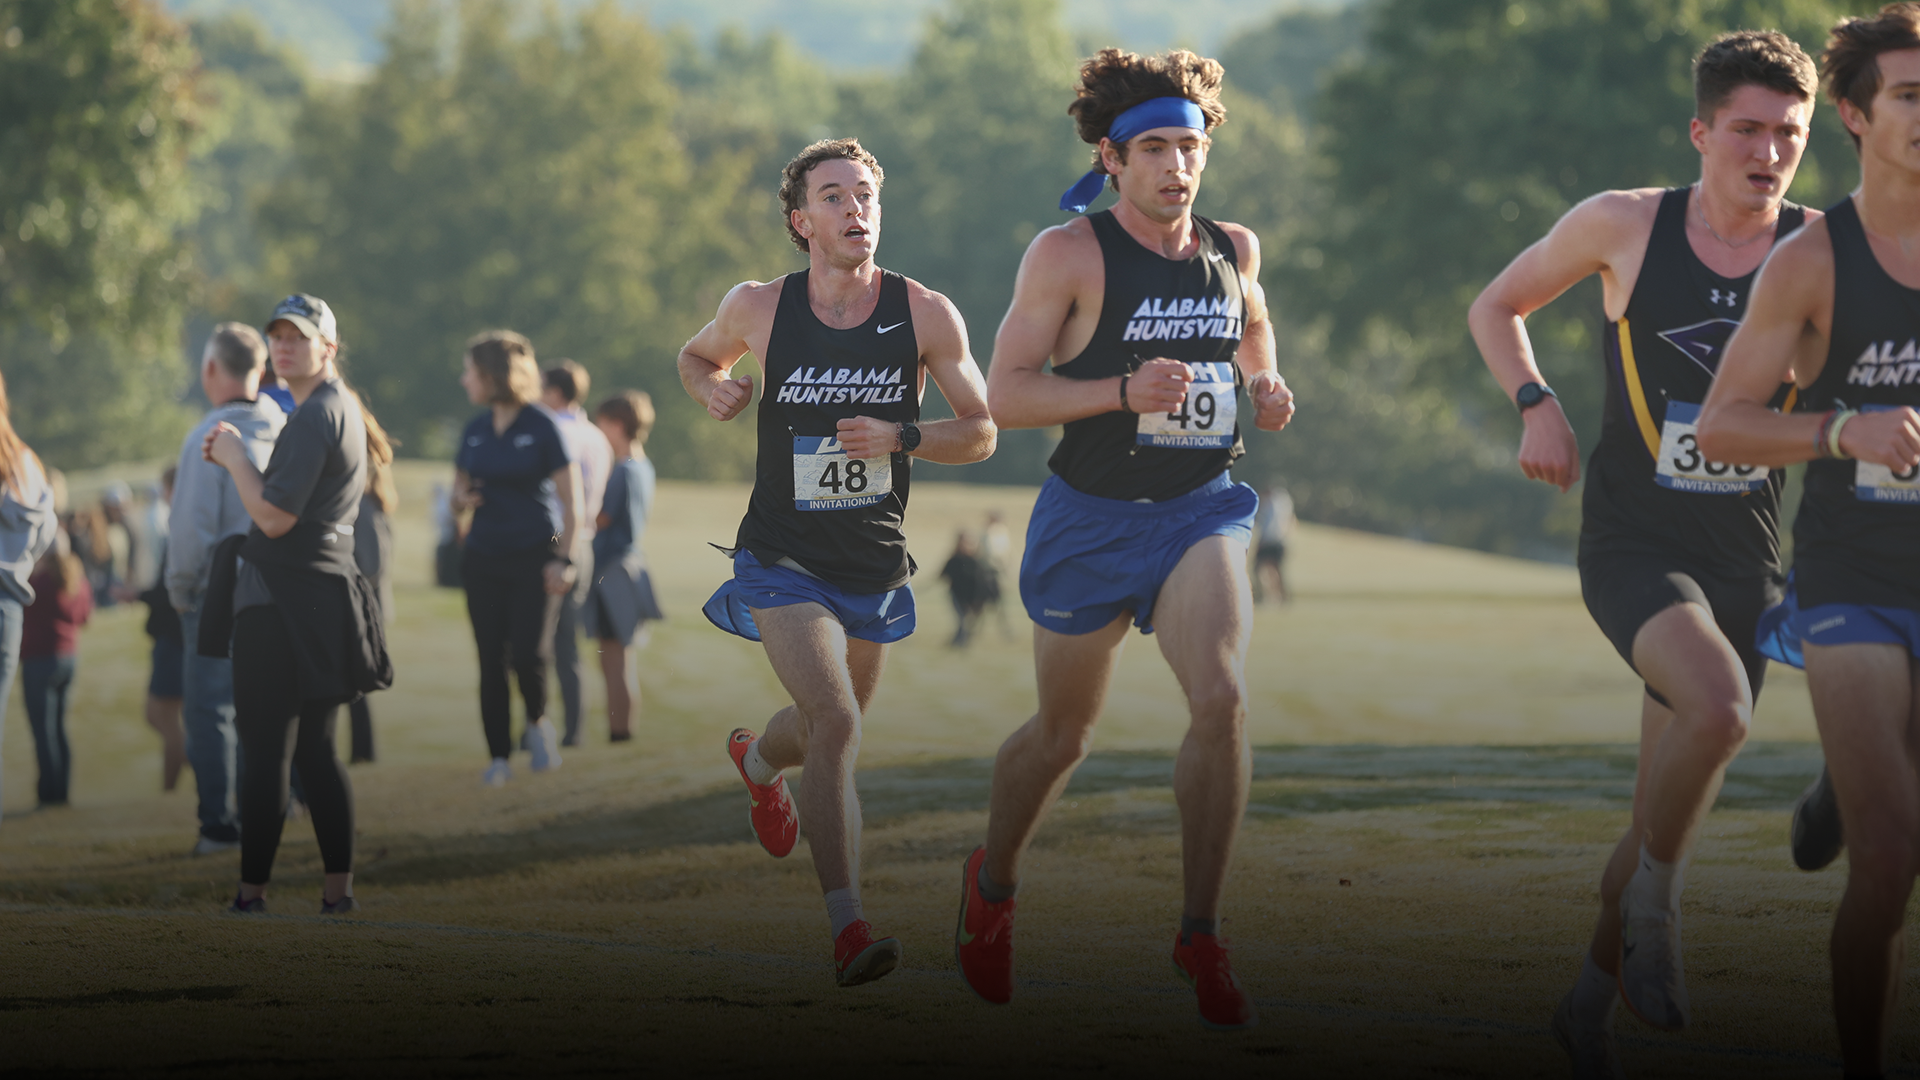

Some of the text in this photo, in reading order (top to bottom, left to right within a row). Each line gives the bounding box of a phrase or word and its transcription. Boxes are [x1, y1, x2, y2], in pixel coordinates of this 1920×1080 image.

[1132, 296, 1241, 319] ALABAMA
[1856, 337, 1920, 365] ALA
[783, 365, 902, 385] ALABAMA
[1846, 362, 1920, 388] HUNT
[776, 384, 908, 405] HUNTSVILLE
[1152, 434, 1222, 447] INVITATIONAL
[818, 459, 868, 494] 48
[1671, 478, 1751, 492] INVITATIONAL
[809, 496, 878, 509] INVITATIONAL
[1874, 487, 1920, 502] INVITA
